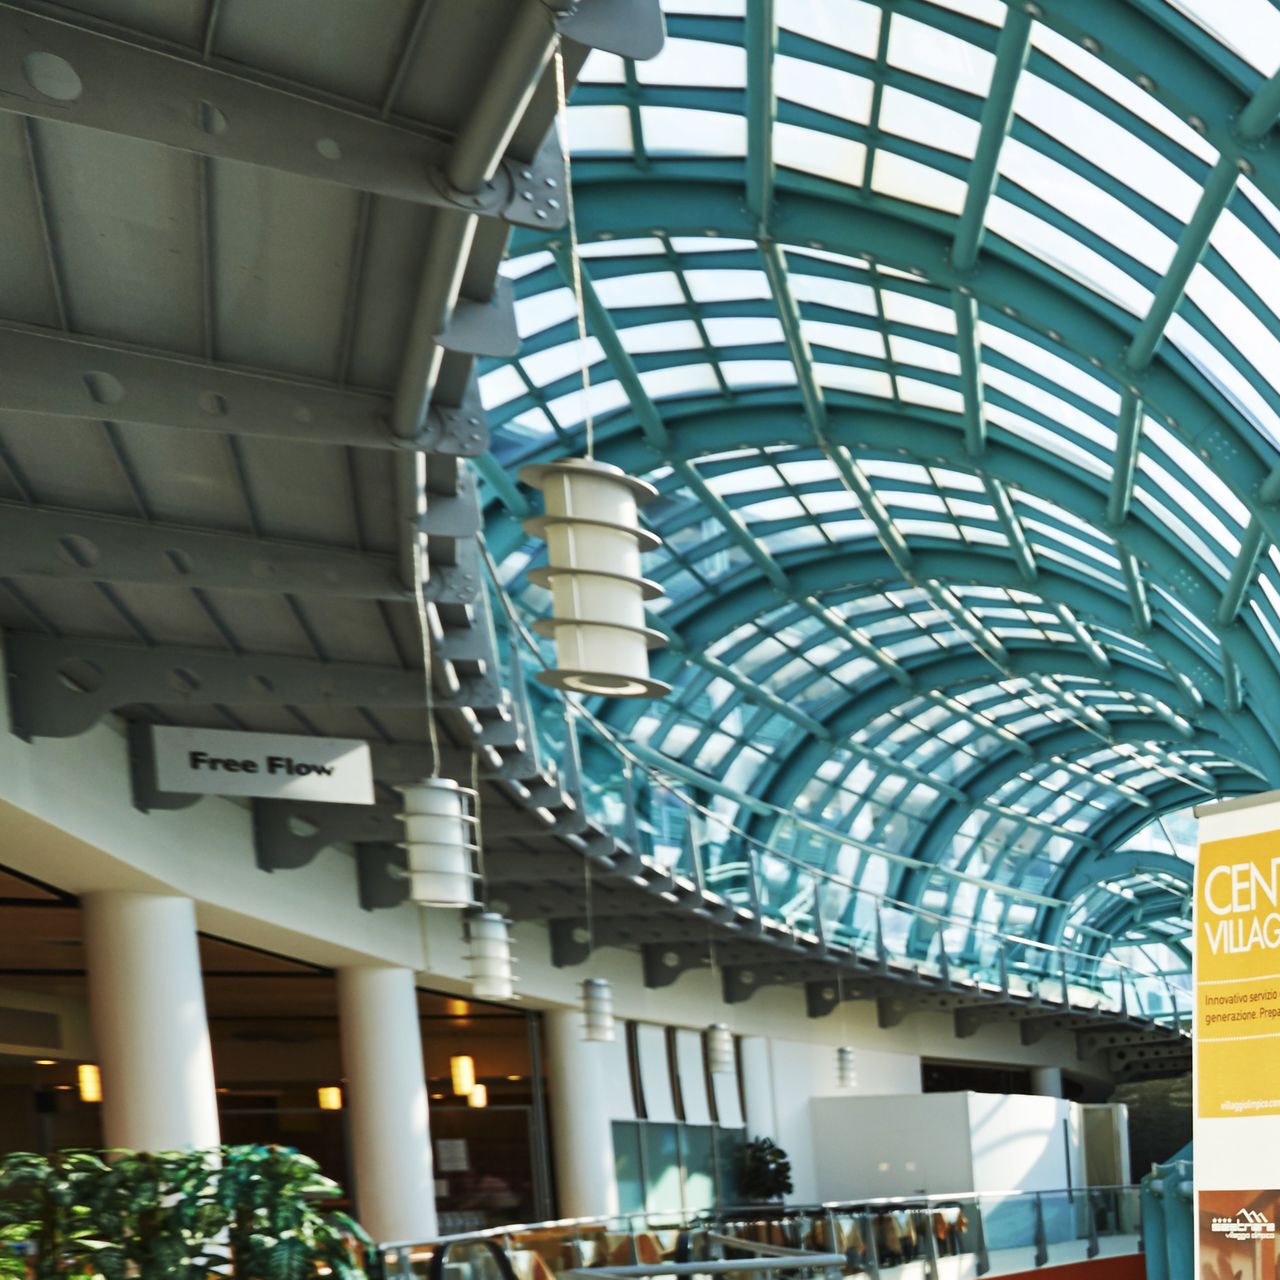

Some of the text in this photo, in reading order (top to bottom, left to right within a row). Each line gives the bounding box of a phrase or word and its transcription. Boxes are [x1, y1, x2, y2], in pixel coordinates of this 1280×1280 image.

[189, 751, 334, 776] Free Flow
[1205, 993, 1248, 1006] Innovativo
[1249, 991, 1278, 1003] servizio
[1205, 1009, 1258, 1027] generazione.
